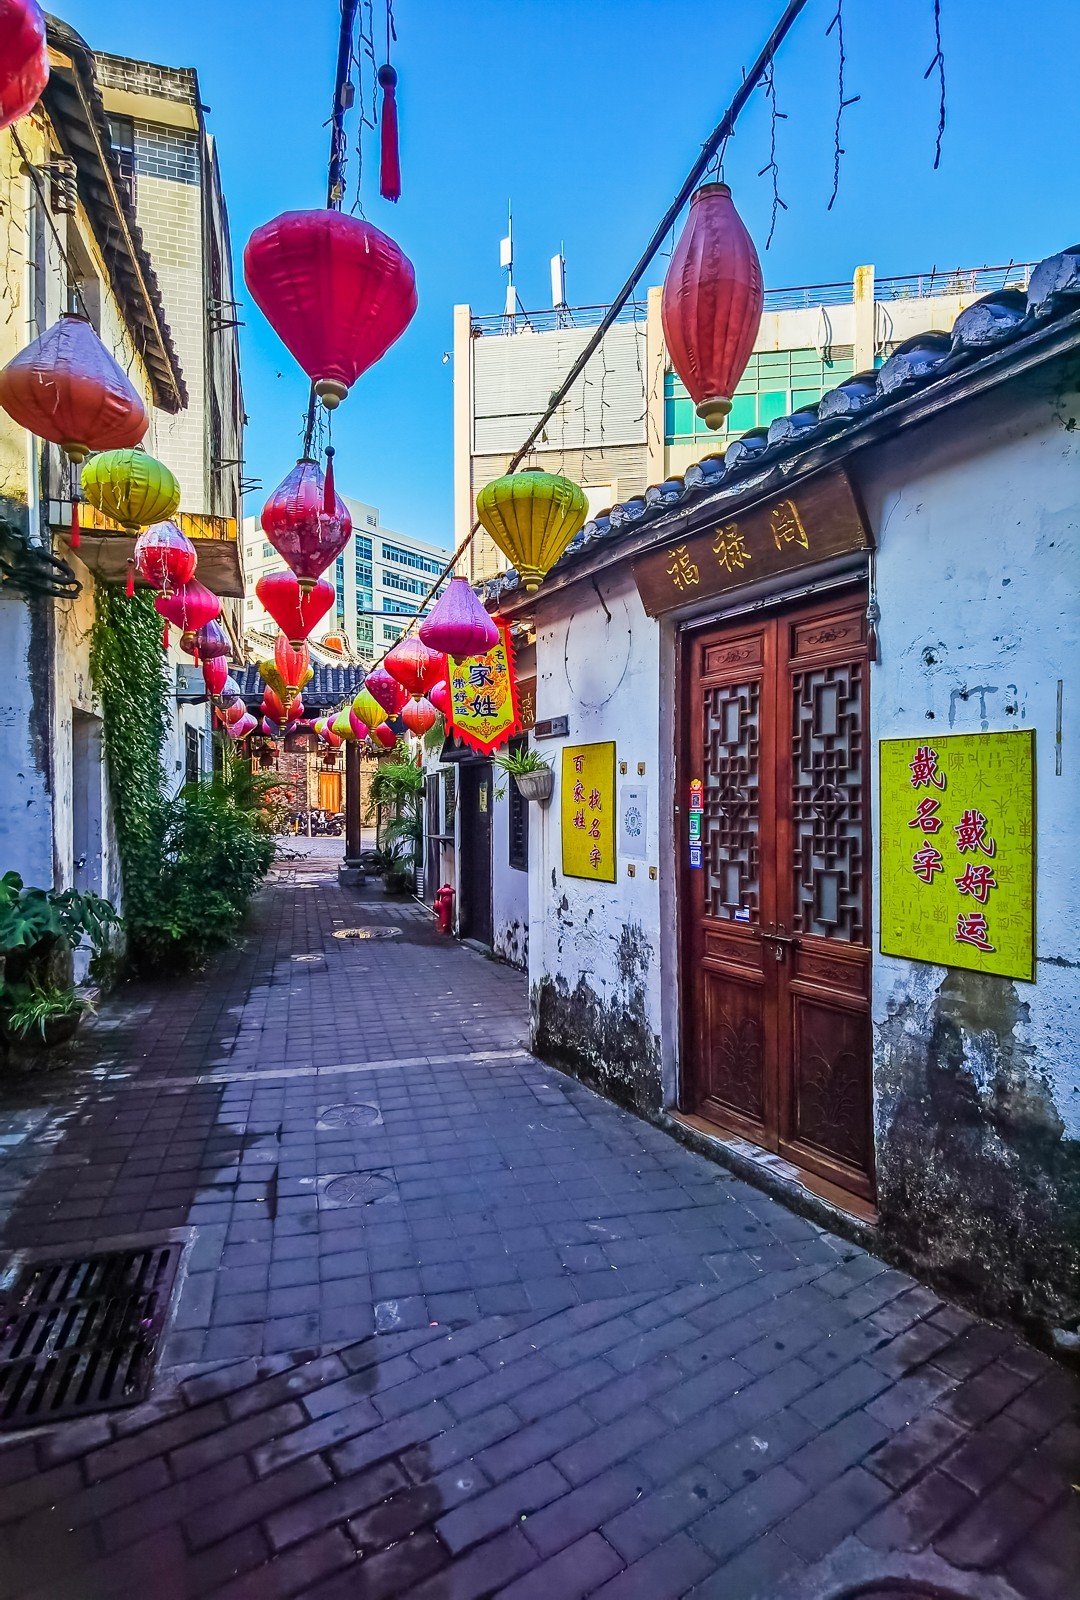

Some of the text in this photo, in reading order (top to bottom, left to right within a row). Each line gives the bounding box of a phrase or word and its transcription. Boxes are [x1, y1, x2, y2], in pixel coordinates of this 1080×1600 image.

[468, 652, 499, 718] 家姓
[572, 754, 587, 830] 百家姓
[587, 788, 603, 870] 找名字
[907, 746, 946, 883] 戴名字
[954, 808, 997, 951] 戴好运
